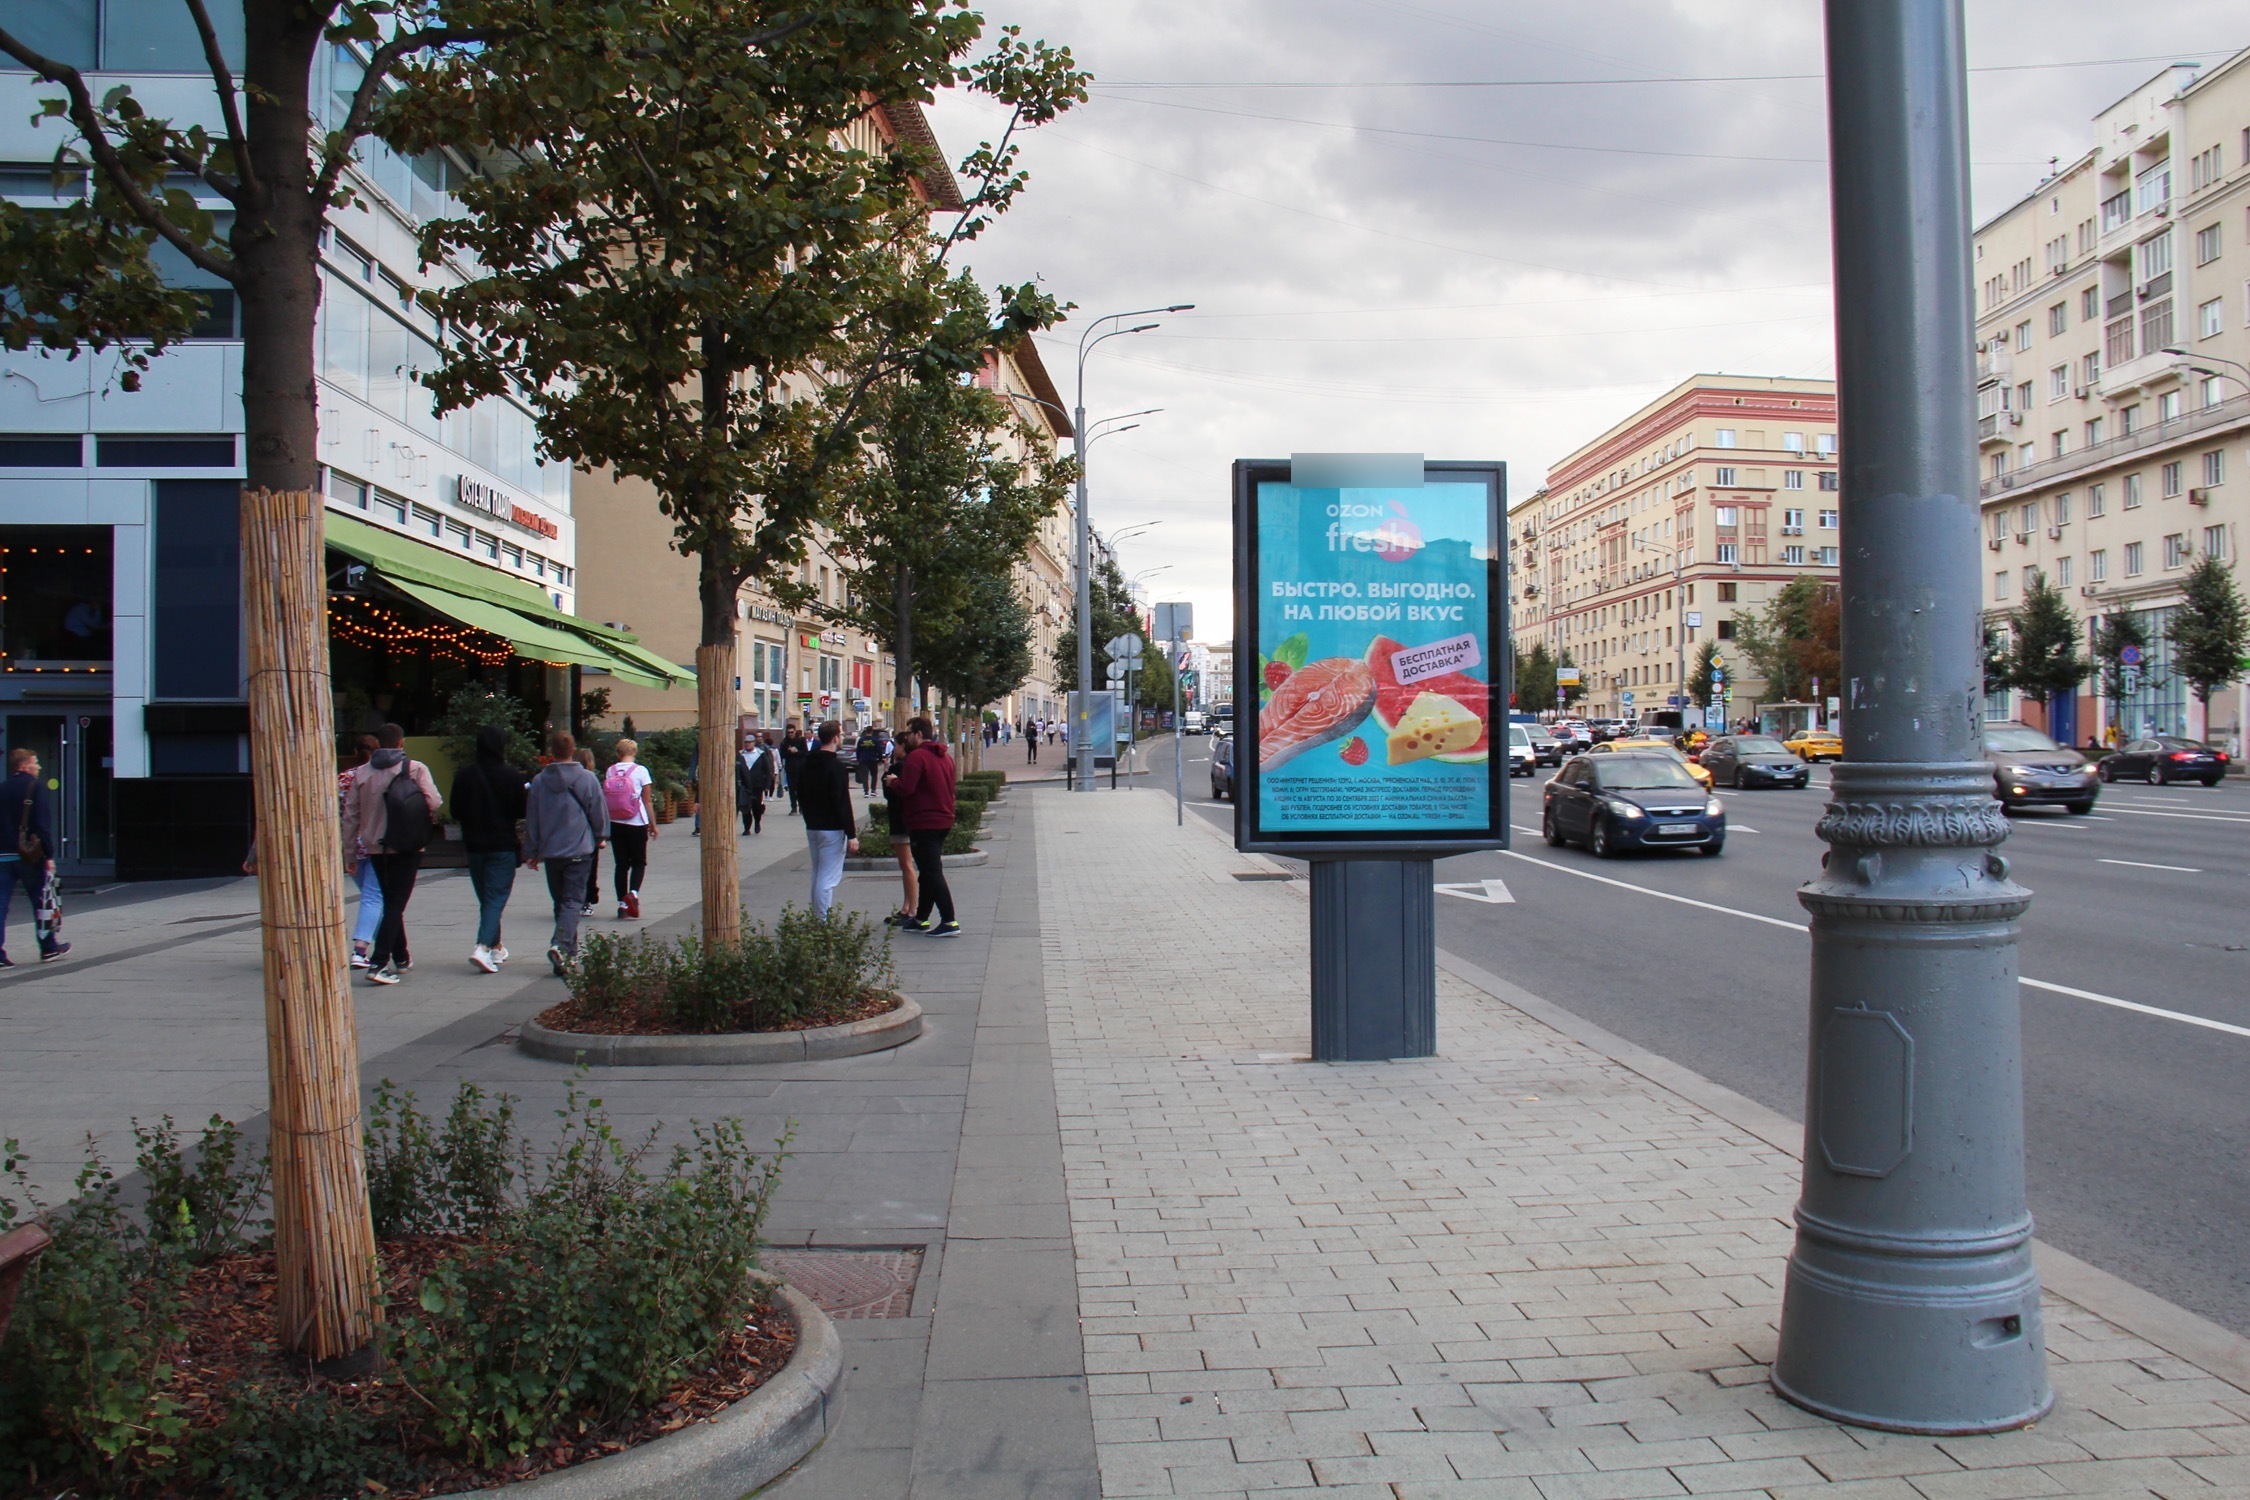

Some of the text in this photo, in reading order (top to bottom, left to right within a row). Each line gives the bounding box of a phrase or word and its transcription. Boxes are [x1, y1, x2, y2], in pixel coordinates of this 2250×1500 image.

[460, 474, 490, 512] OSTERIA
[491, 489, 512, 522] MARIO
[1326, 504, 1383, 517] OZON
[1326, 522, 1410, 552] fresh
[1272, 582, 1476, 600] БЫСТРО. ВЫГОДНО.
[1284, 602, 1464, 620] НА ЛЮБОЙ ВКУС
[1399, 640, 1470, 666] БЕСПЛАТНАЯ
